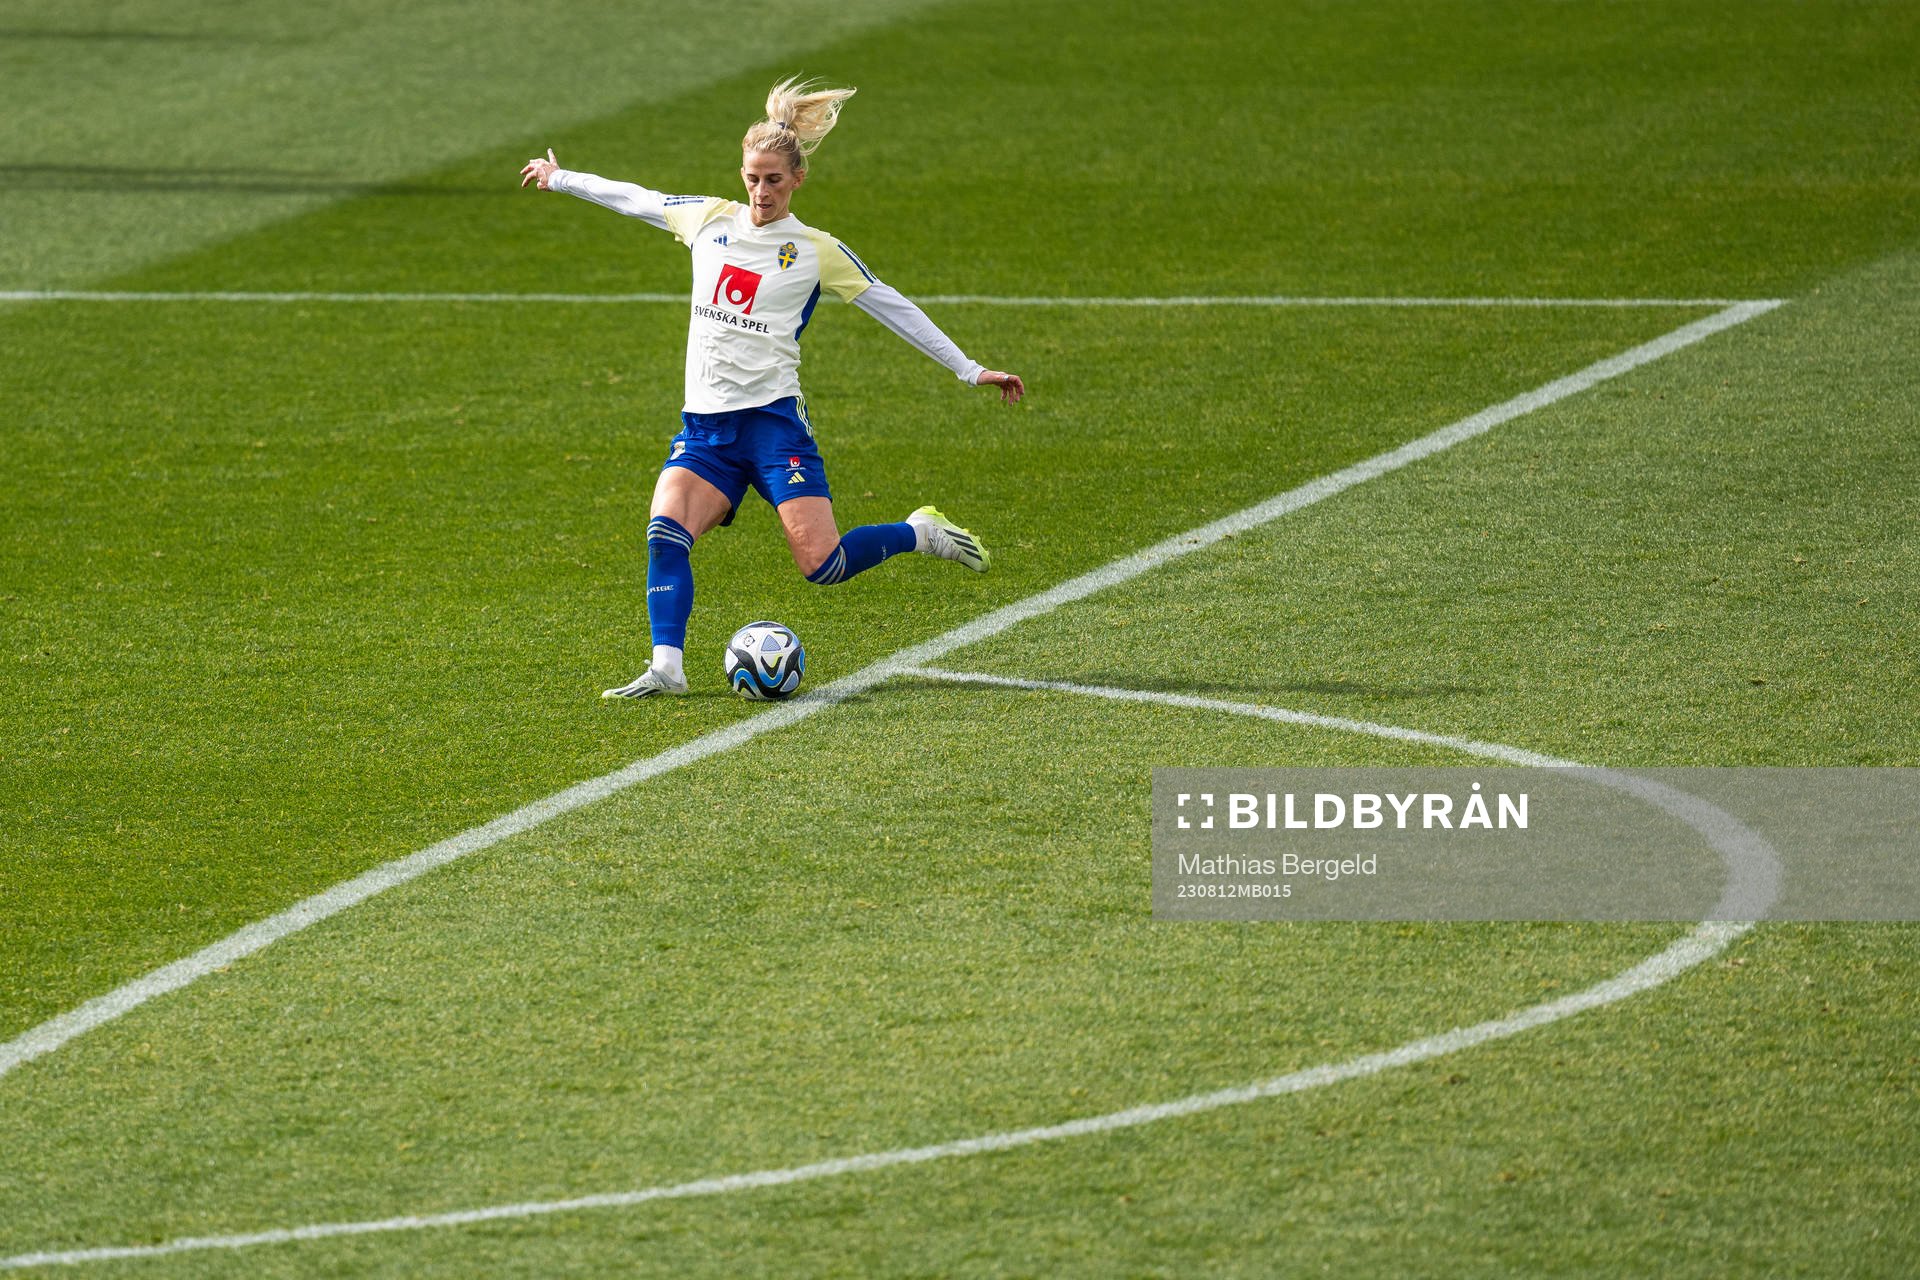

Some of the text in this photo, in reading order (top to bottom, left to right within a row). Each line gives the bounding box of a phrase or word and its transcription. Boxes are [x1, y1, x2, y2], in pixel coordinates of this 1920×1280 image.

[694, 305, 770, 334] SVENSKA SPEL
[647, 584, 674, 596] RIGE
